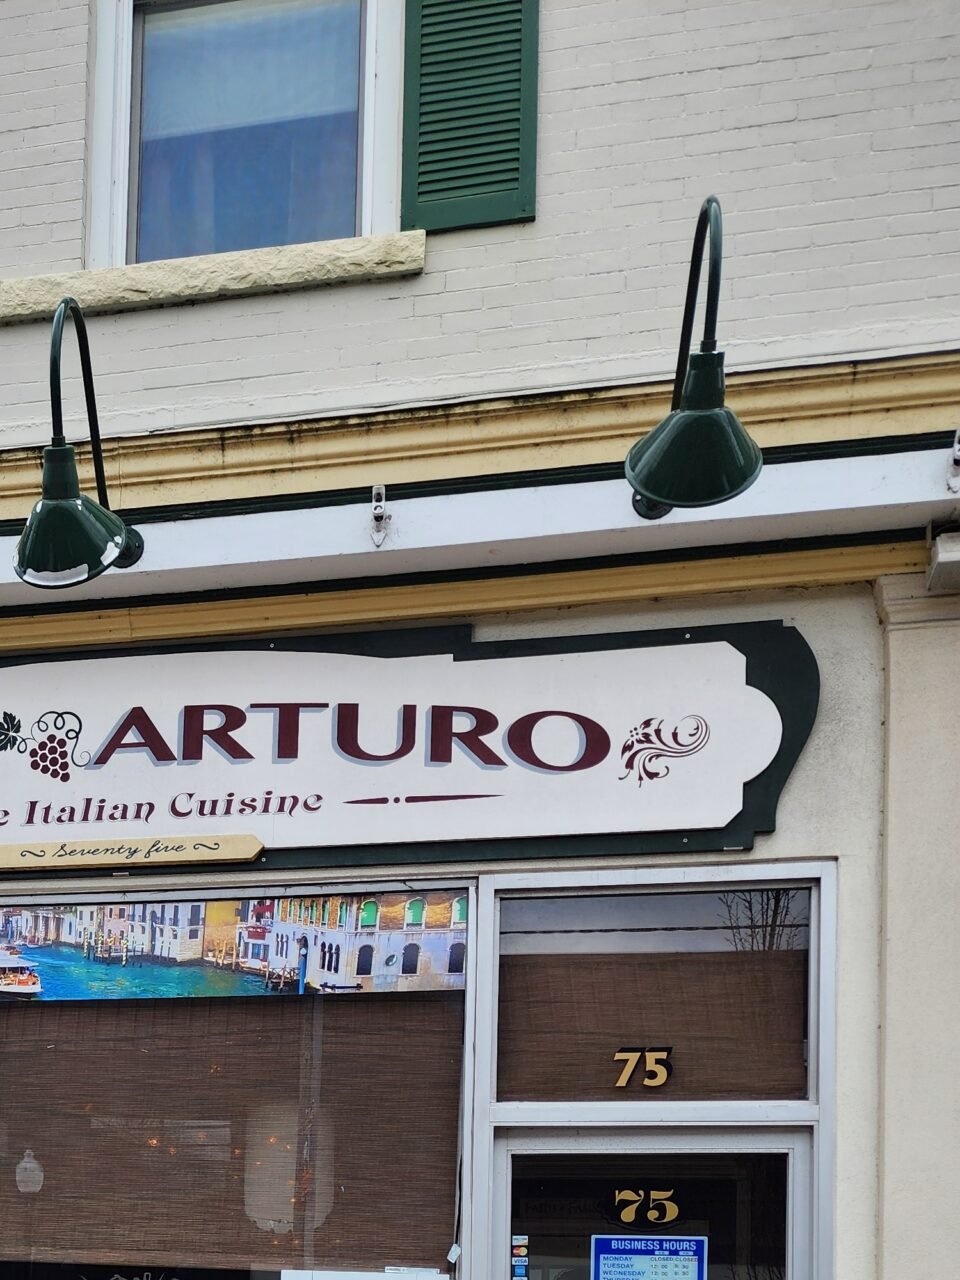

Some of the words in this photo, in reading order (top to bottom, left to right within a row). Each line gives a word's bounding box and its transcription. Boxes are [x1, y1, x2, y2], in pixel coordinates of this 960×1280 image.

[87, 702, 611, 772] ARTURO
[21, 797, 155, 827] Italian
[168, 790, 323, 818] Cuisine
[52, 843, 141, 859] Seventy
[143, 840, 187, 859] five
[613, 1048, 671, 1087] 75
[615, 1189, 679, 1223] 75
[611, 1240, 660, 1250] BUSINESS
[663, 1241, 696, 1251] HOURS
